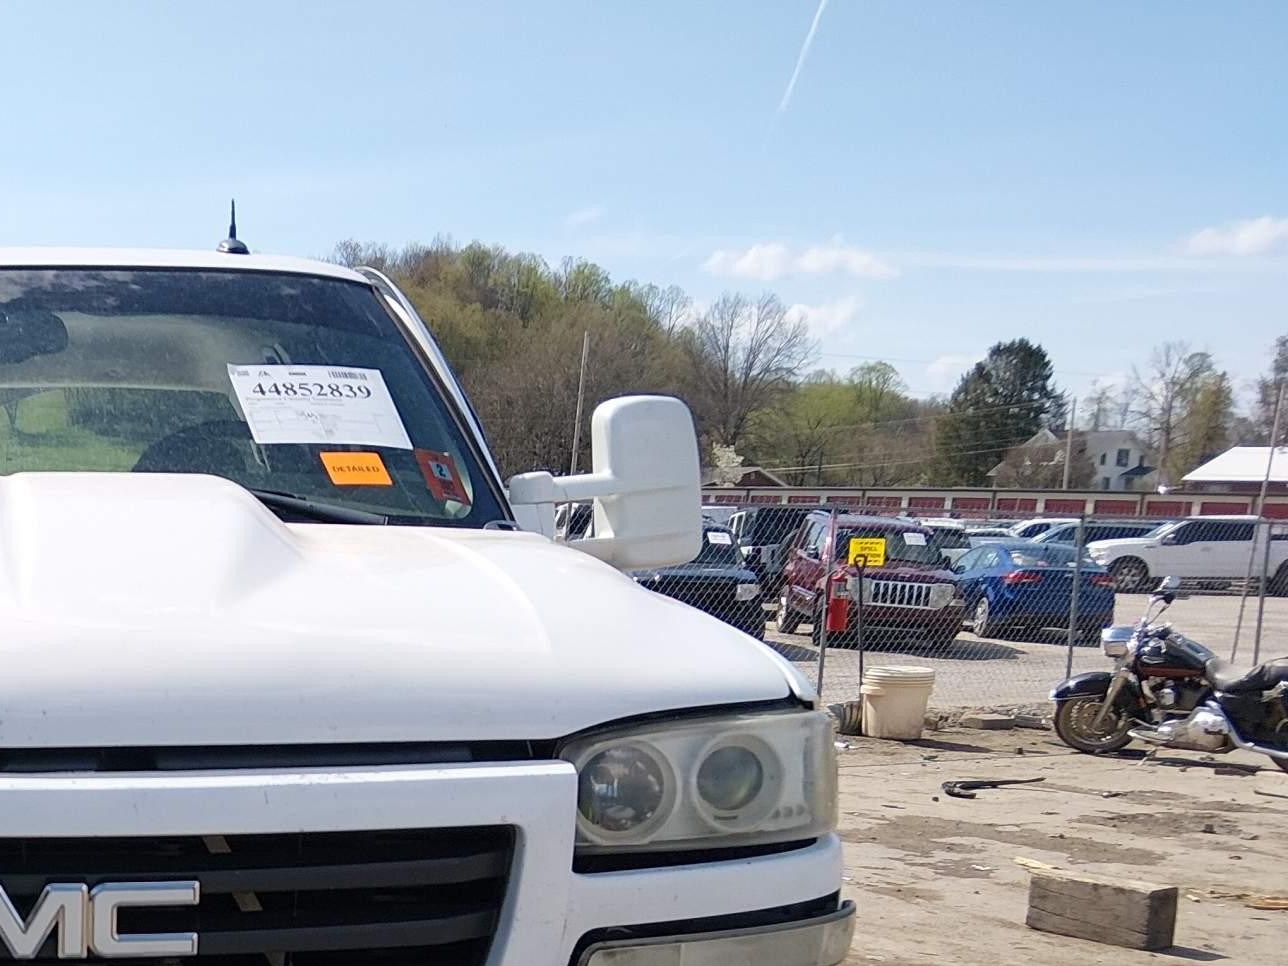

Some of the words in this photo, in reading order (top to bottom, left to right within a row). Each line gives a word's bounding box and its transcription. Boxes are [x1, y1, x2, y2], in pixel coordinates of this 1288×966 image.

[252, 382, 372, 399] 44852839
[332, 465, 381, 474] DETAILED
[435, 463, 447, 478] 2
